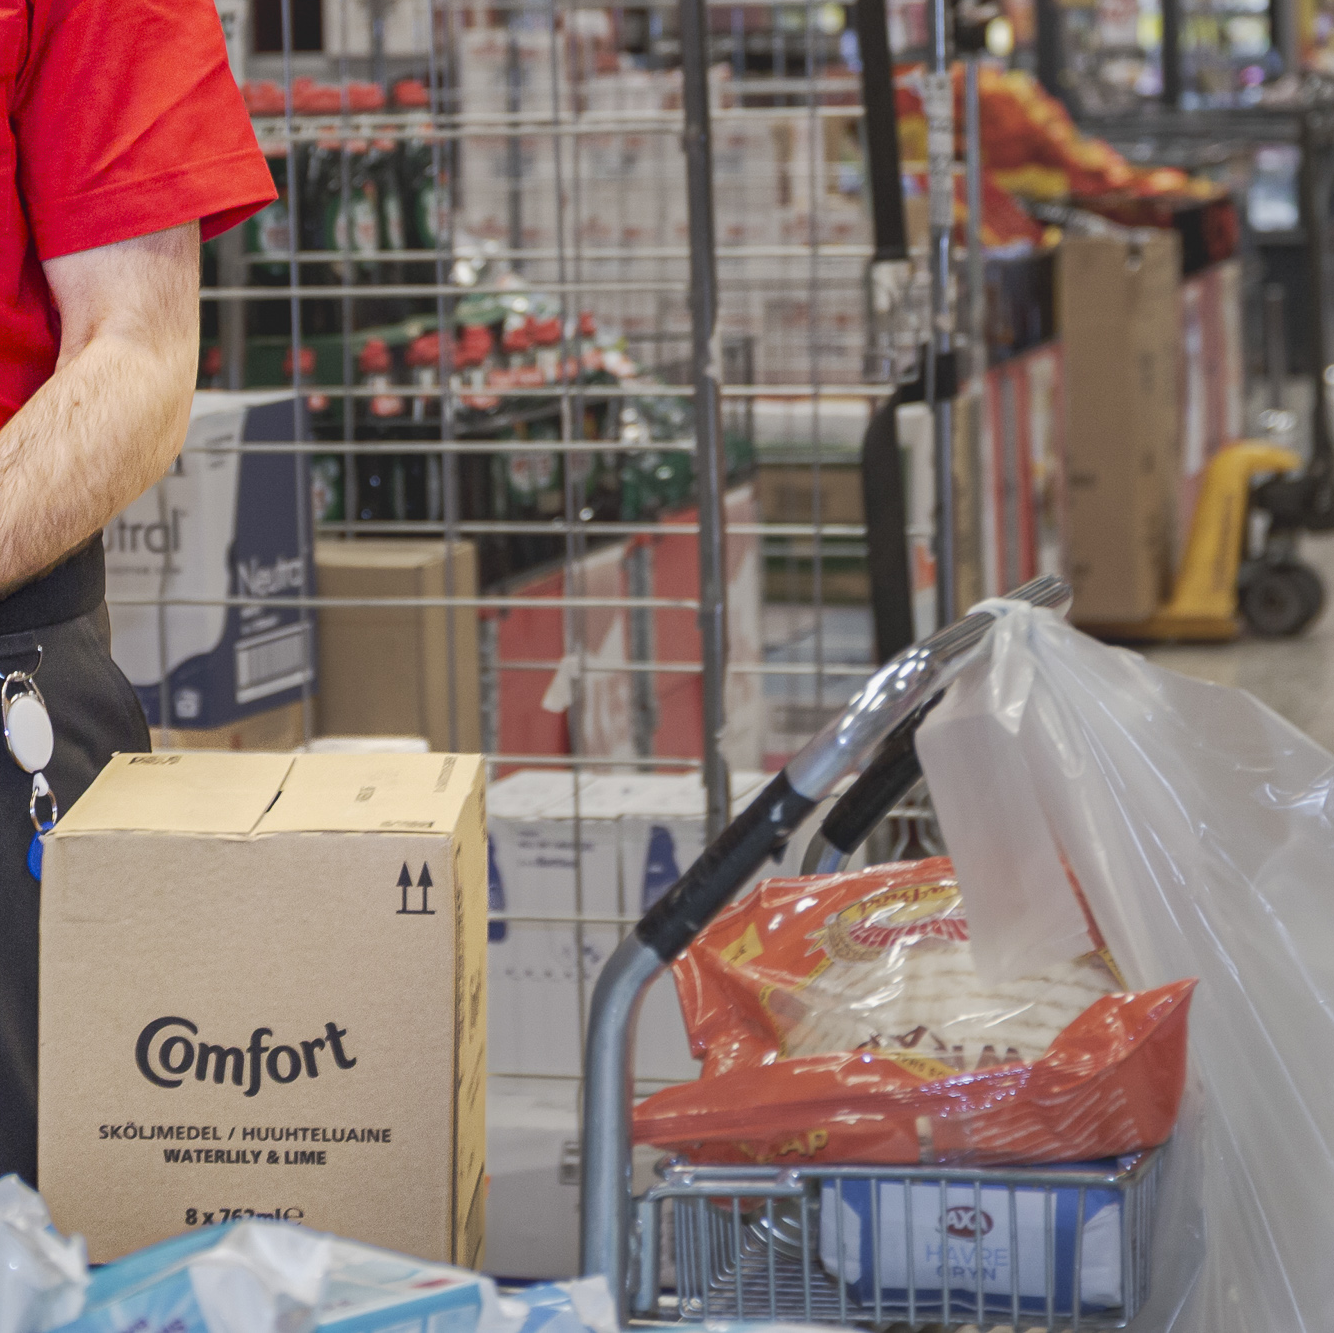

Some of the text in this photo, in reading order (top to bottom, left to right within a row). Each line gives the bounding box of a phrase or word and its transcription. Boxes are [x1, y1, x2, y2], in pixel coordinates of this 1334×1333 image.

[134, 1015, 358, 1098] Comfort
[98, 1122, 222, 1141] SKÖLJMEDEL
[242, 1127, 392, 1144] HUUHTELUAINE
[163, 1148, 327, 1166] WATERLILY & LIME
[185, 1208, 198, 1226] 8
[201, 1212, 215, 1226] x
